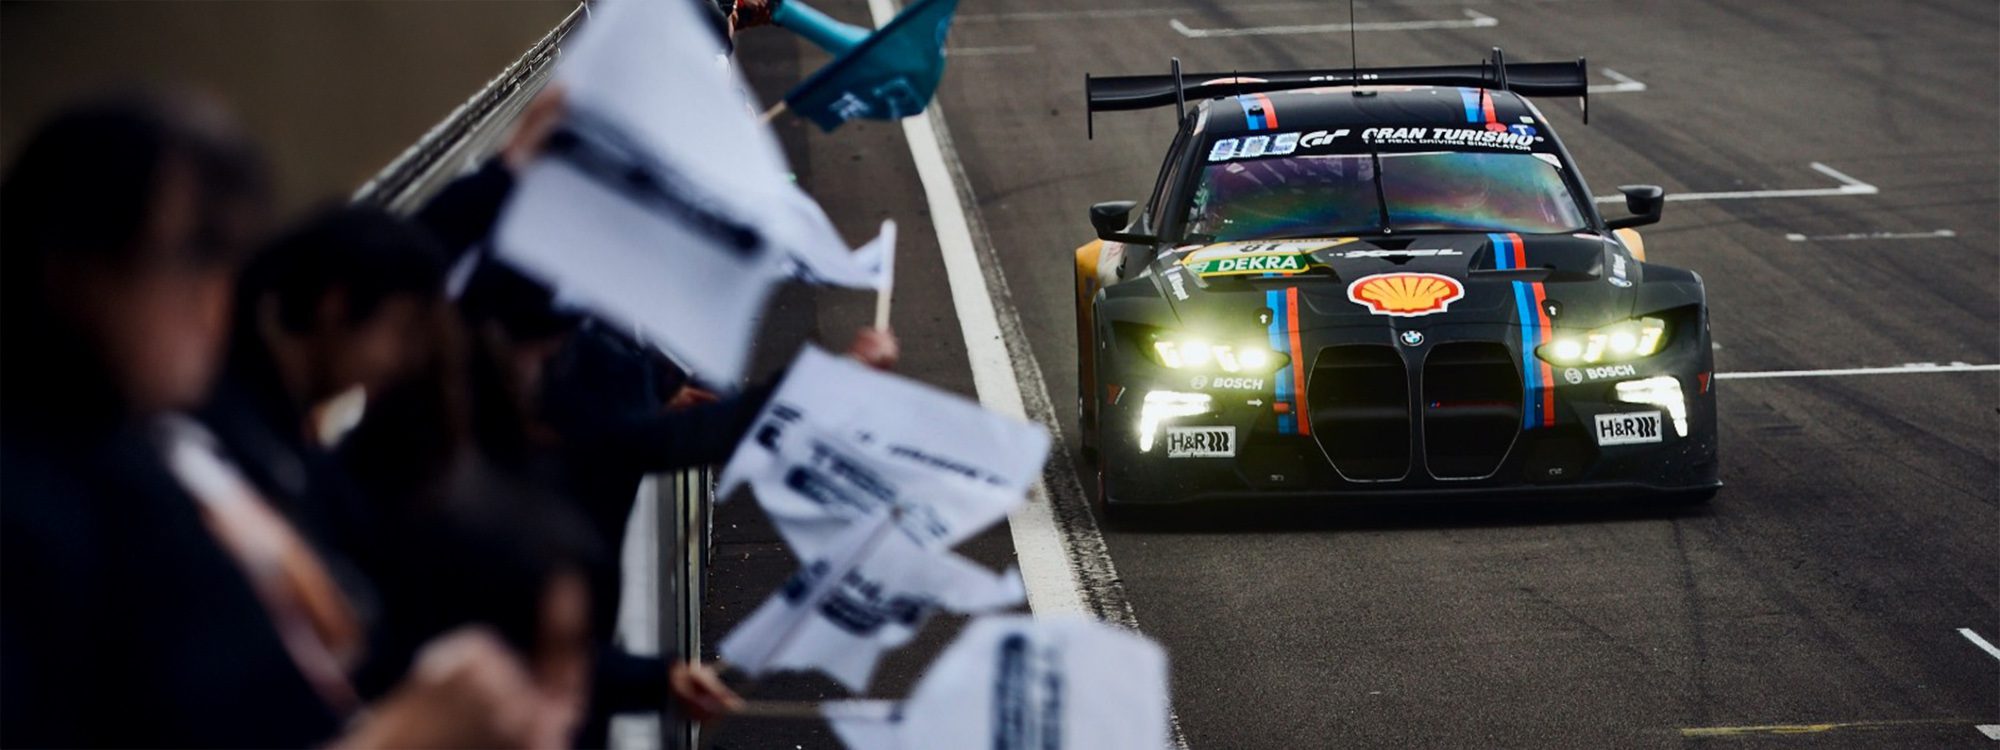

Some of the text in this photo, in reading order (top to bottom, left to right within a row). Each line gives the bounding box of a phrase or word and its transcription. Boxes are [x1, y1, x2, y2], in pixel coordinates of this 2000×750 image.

[1361, 127, 1427, 139] GRAN
[1432, 127, 1534, 147] TURISMO
[1217, 255, 1298, 271] DEKRA
[1587, 364, 1636, 380] BOSCH
[1213, 377, 1264, 390] BOSCH
[1600, 418, 1636, 438] H&R
[1171, 432, 1206, 450] H&R
